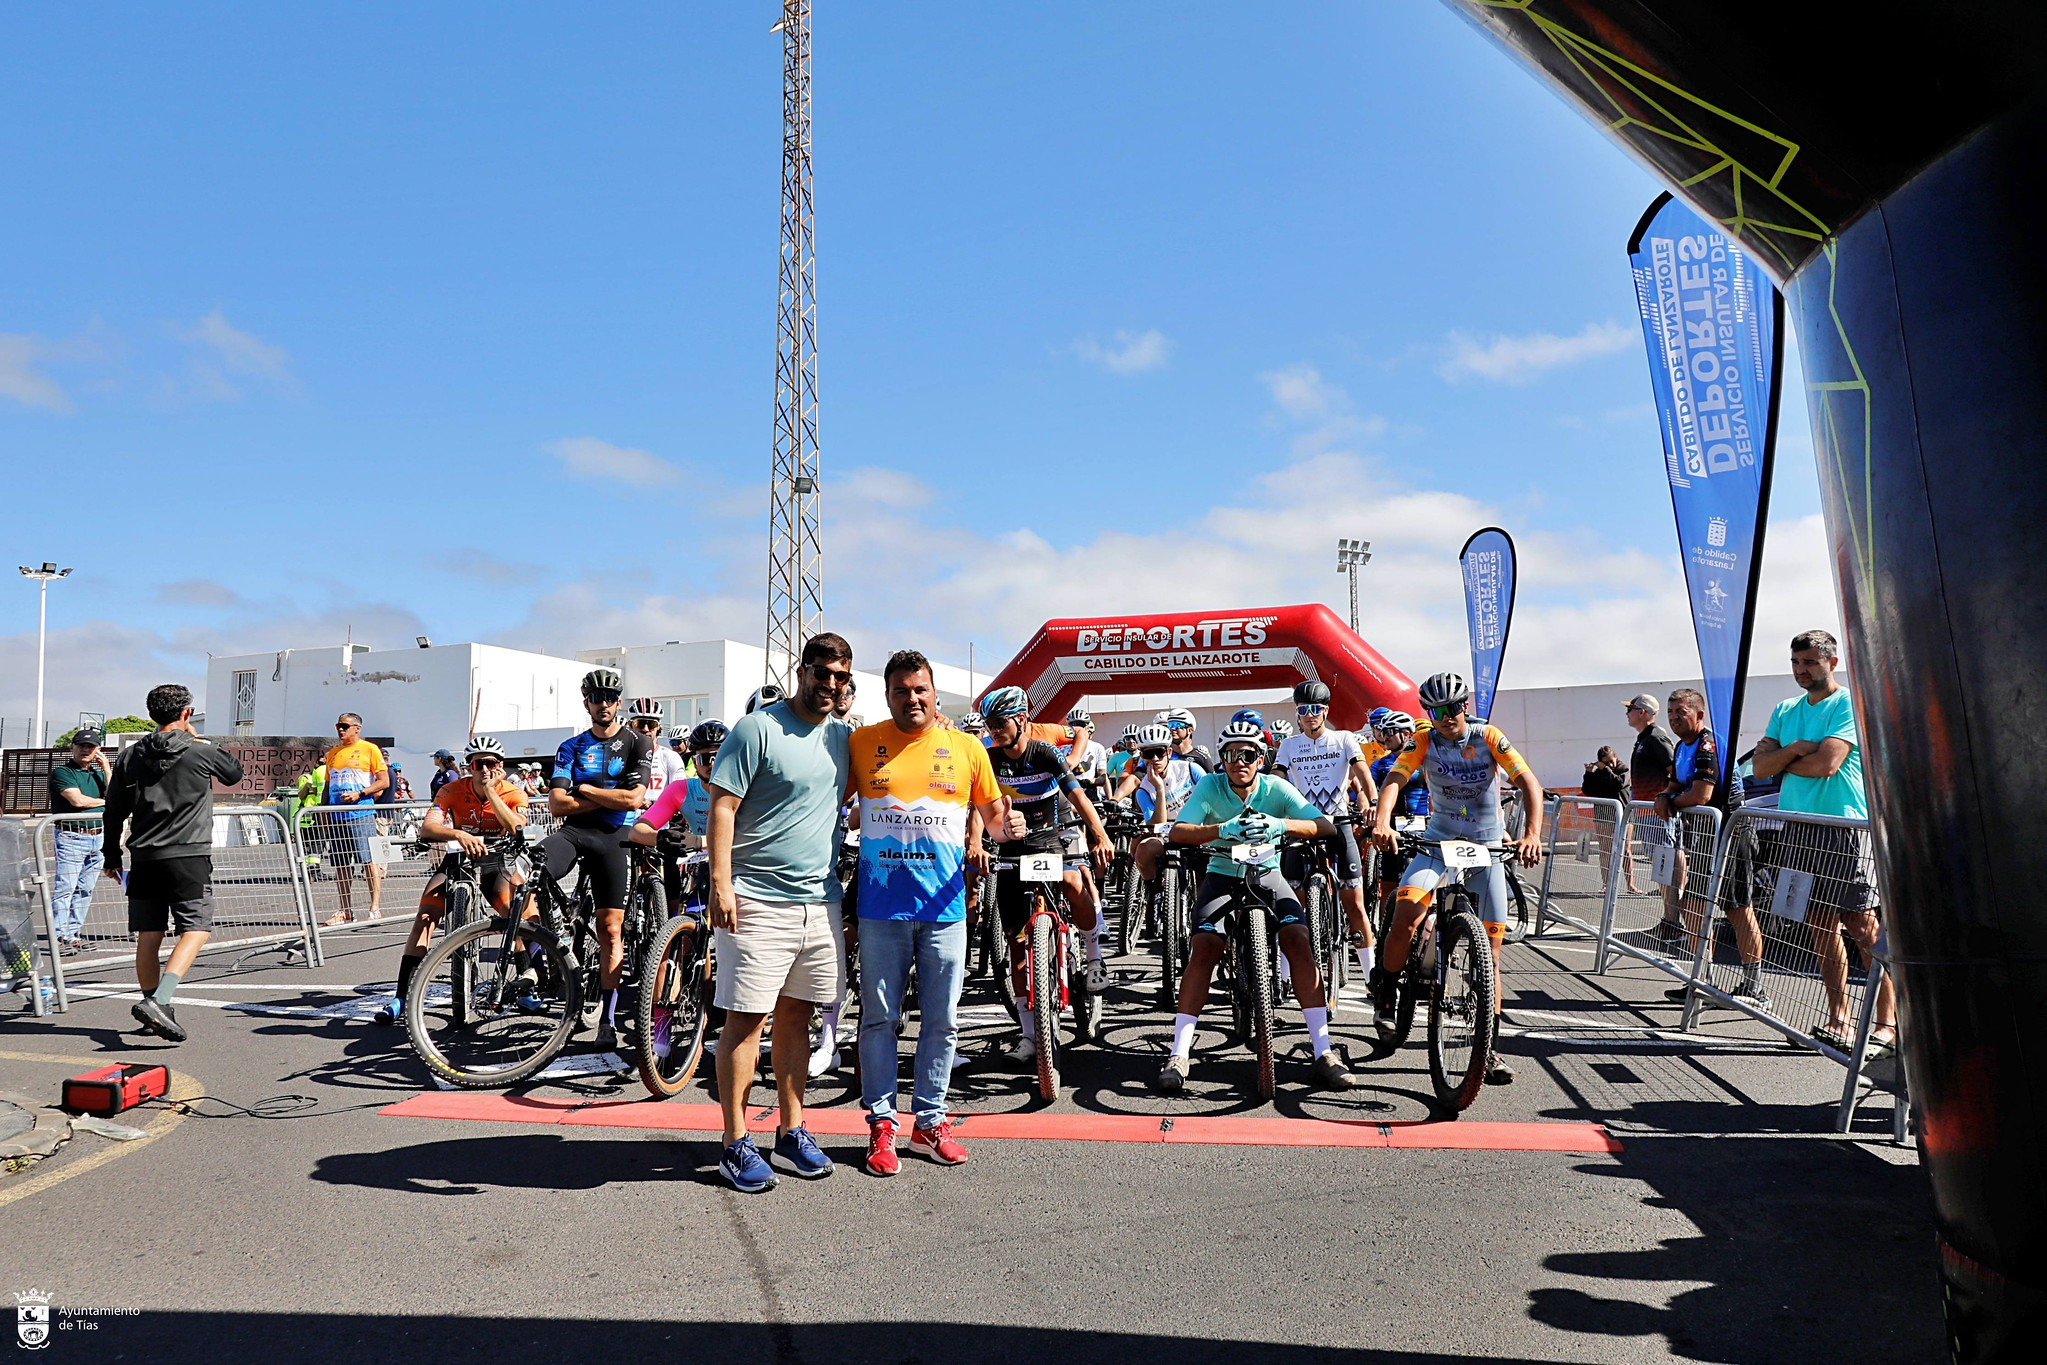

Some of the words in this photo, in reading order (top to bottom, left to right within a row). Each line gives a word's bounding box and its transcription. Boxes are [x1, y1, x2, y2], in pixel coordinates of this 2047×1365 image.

[1076, 621, 1267, 652] DEPORTES
[1084, 635, 1122, 644] SERVICIO
[1124, 633, 1159, 642] INSULAR
[1084, 657, 1146, 669] CABILDO
[1150, 656, 1170, 667] DE
[1173, 652, 1260, 666] LANZAROTE
[1292, 751, 1341, 763] cannondale
[1297, 762, 1337, 771] ARABAY
[241, 778, 265, 790] DE
[871, 813, 948, 826] LANZAROTE
[1249, 848, 1258, 858] 6
[1455, 846, 1477, 858] 22
[1032, 859, 1051, 871] 21
